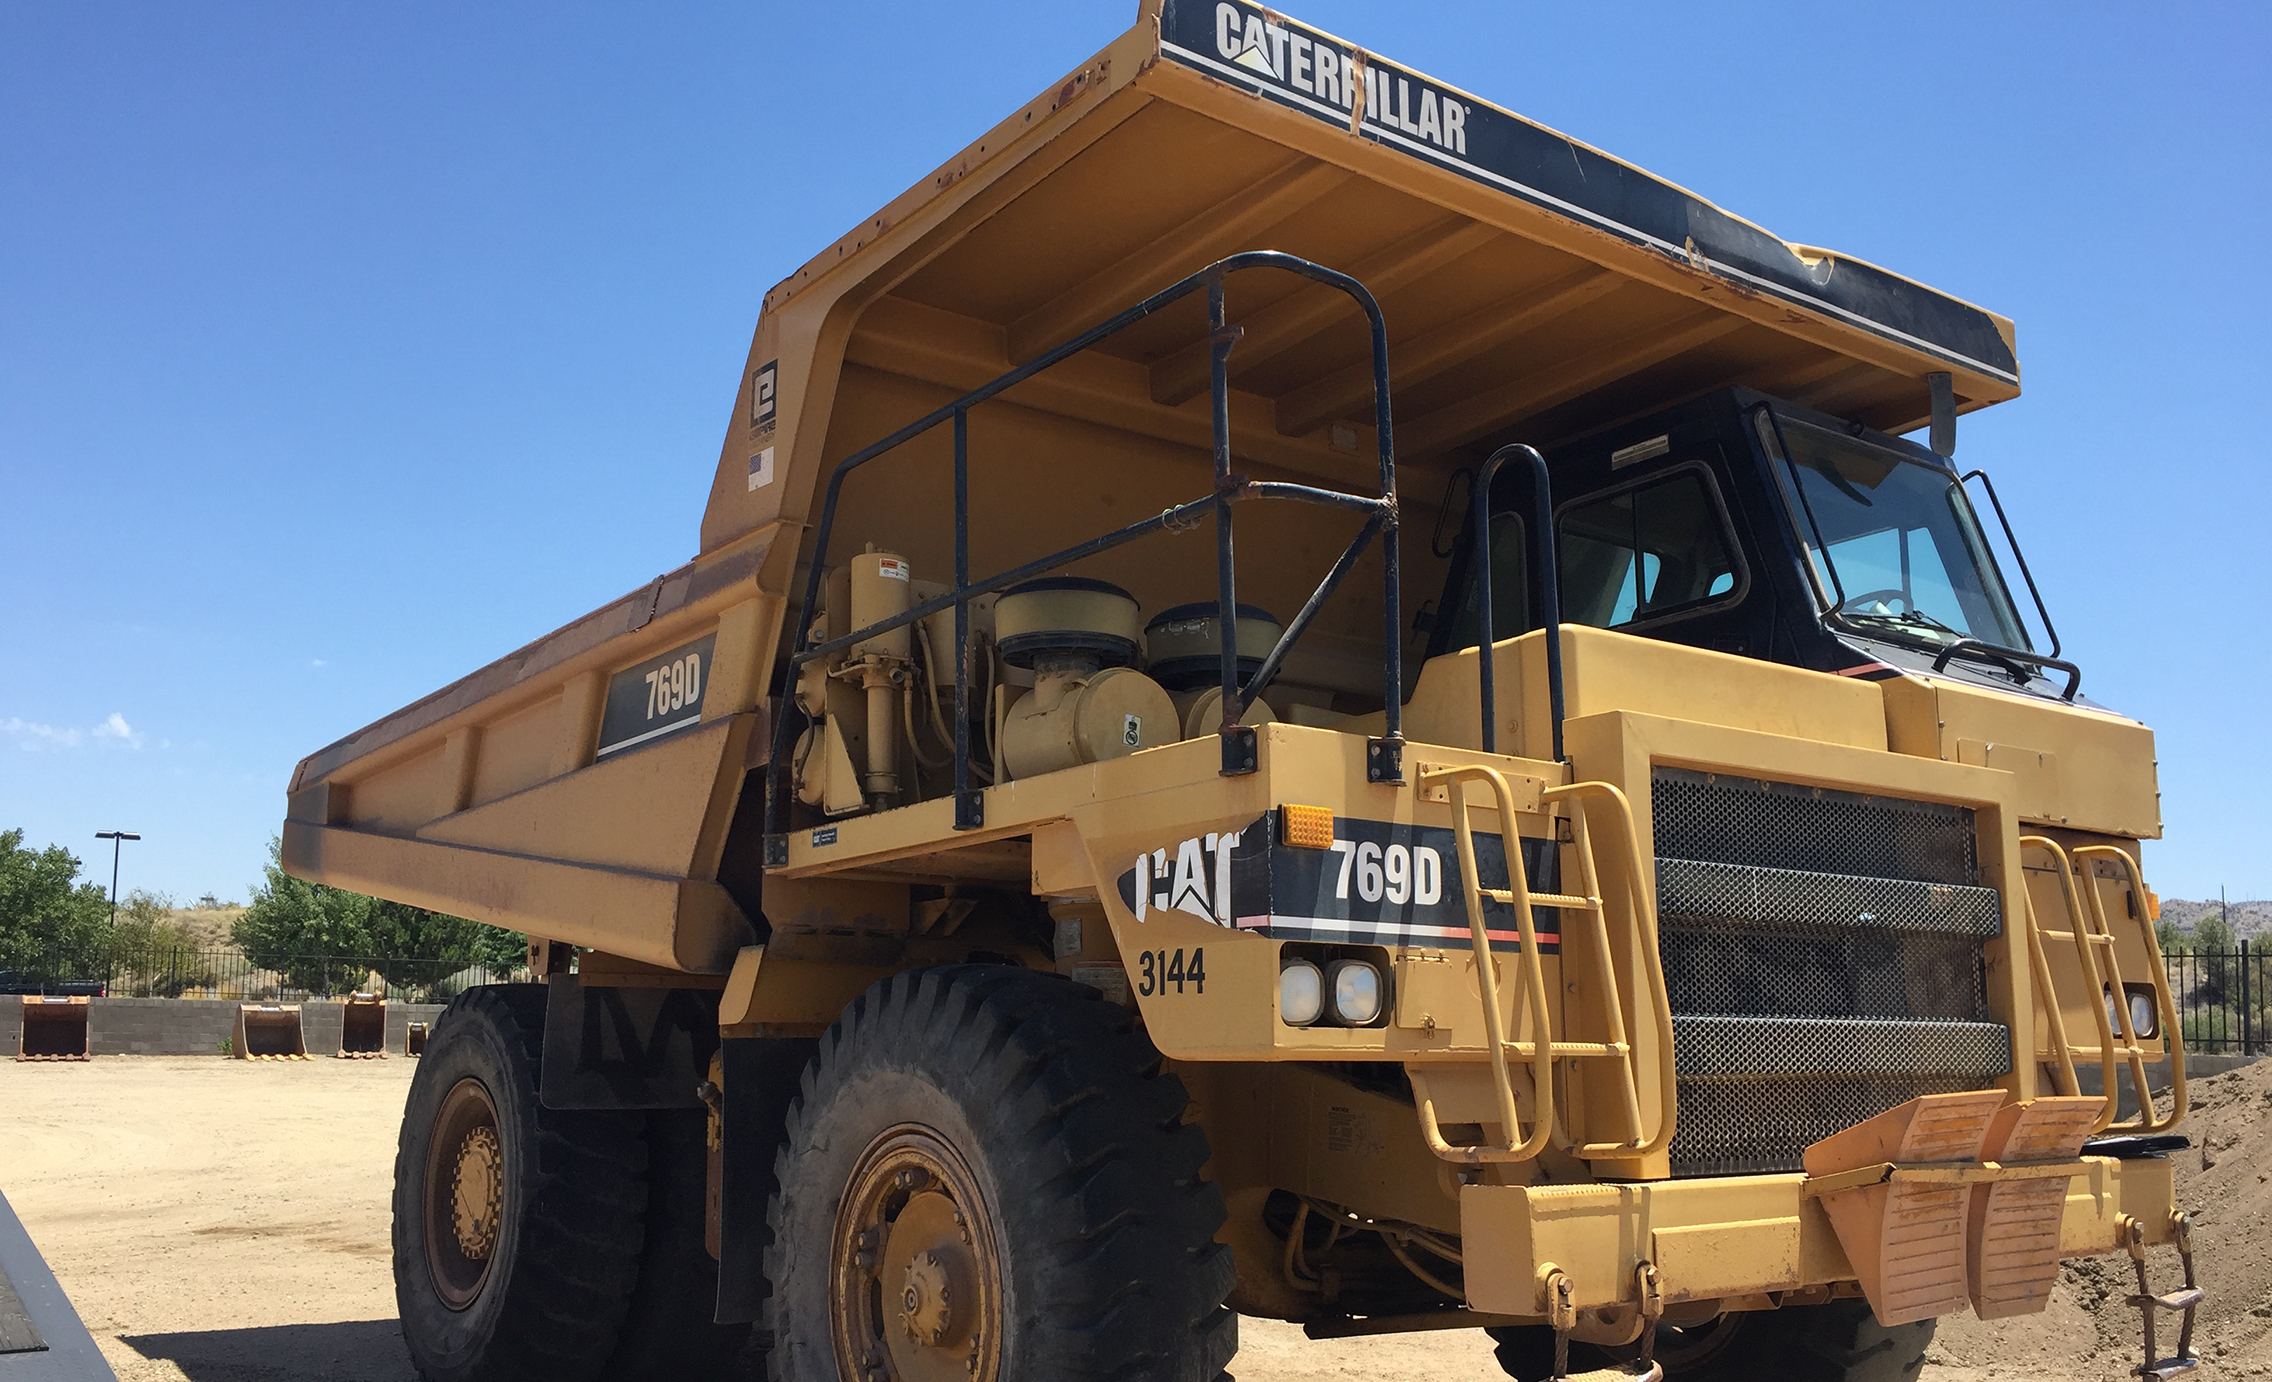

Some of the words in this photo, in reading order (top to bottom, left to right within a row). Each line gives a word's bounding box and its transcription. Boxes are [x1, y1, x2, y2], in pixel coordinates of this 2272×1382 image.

[645, 653, 700, 720] 769D
[1330, 839, 1442, 905] 769D
[1138, 947, 1206, 997] 3144
